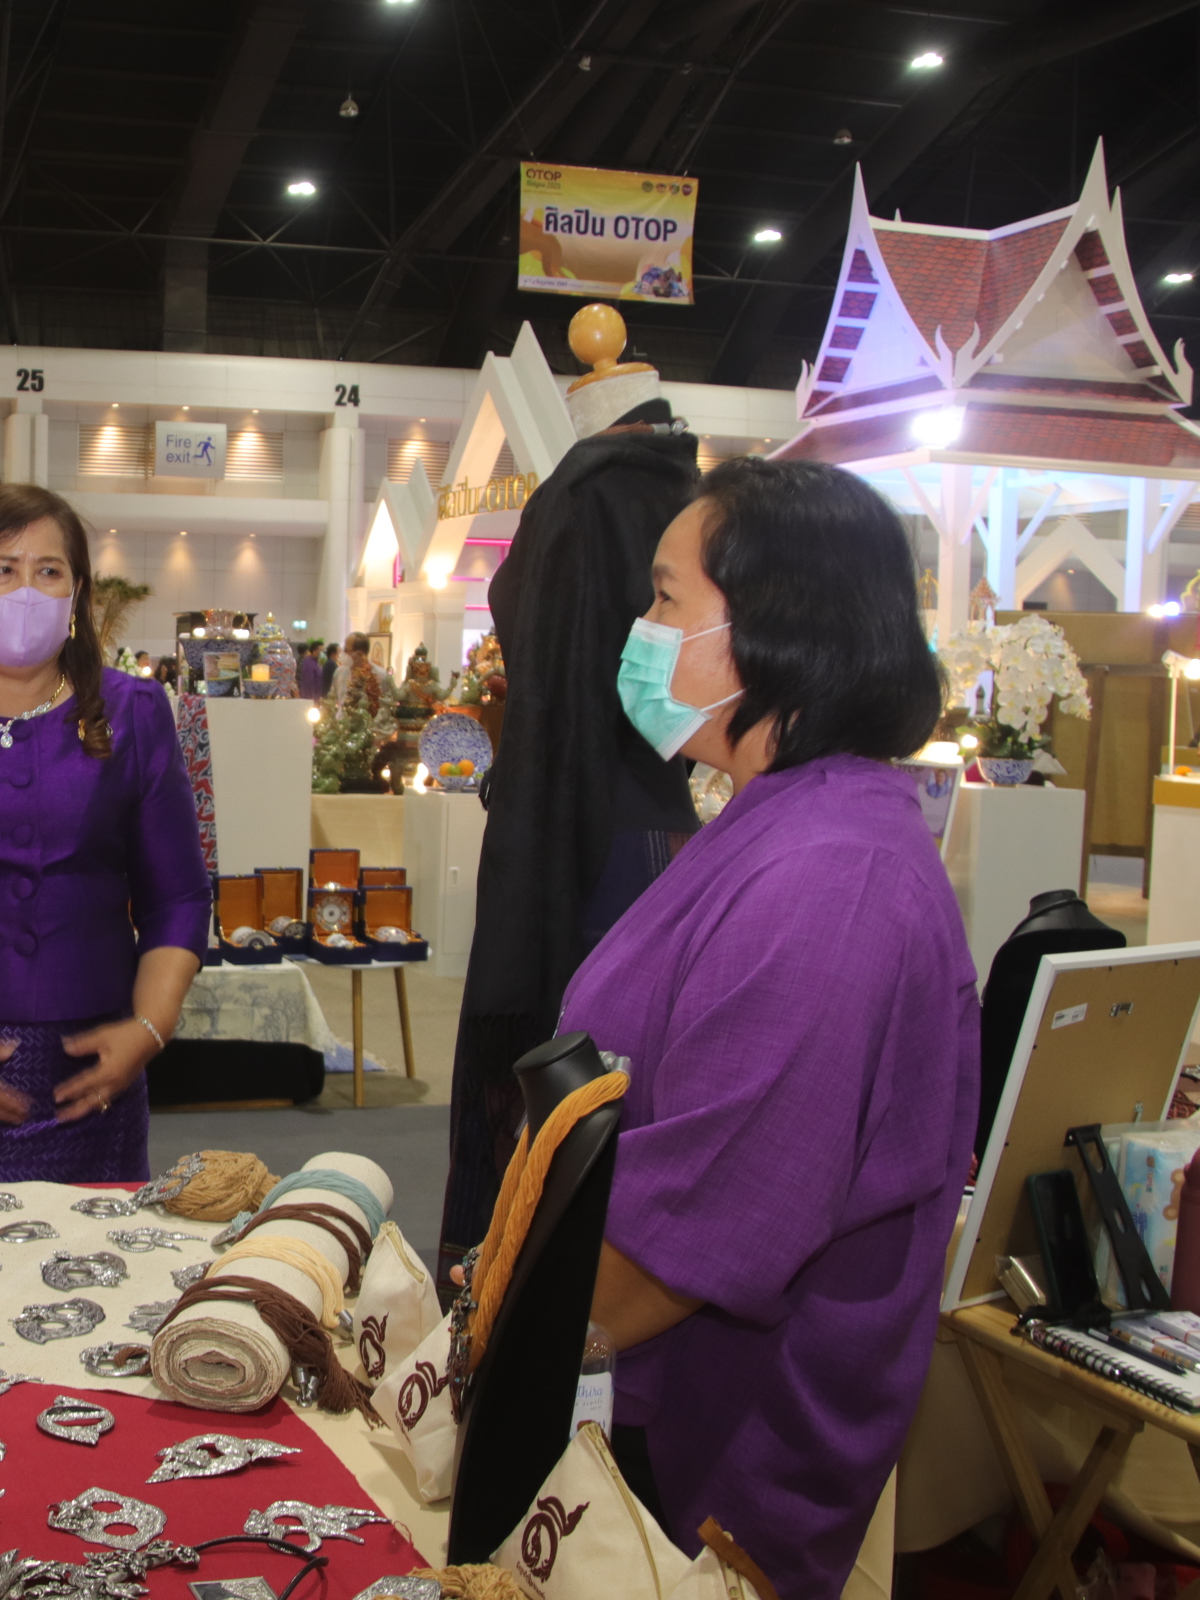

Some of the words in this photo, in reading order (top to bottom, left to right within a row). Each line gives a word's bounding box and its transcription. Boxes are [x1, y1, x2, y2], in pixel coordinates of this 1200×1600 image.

[526, 168, 562, 181] OTOP
[544, 206, 605, 237] ศิลปิน
[613, 215, 678, 242] OTOP
[16, 368, 45, 392] 25
[335, 384, 361, 407] 24
[166, 434, 192, 449] Fire
[166, 450, 191, 464] exit
[485, 472, 538, 513] OTOP
